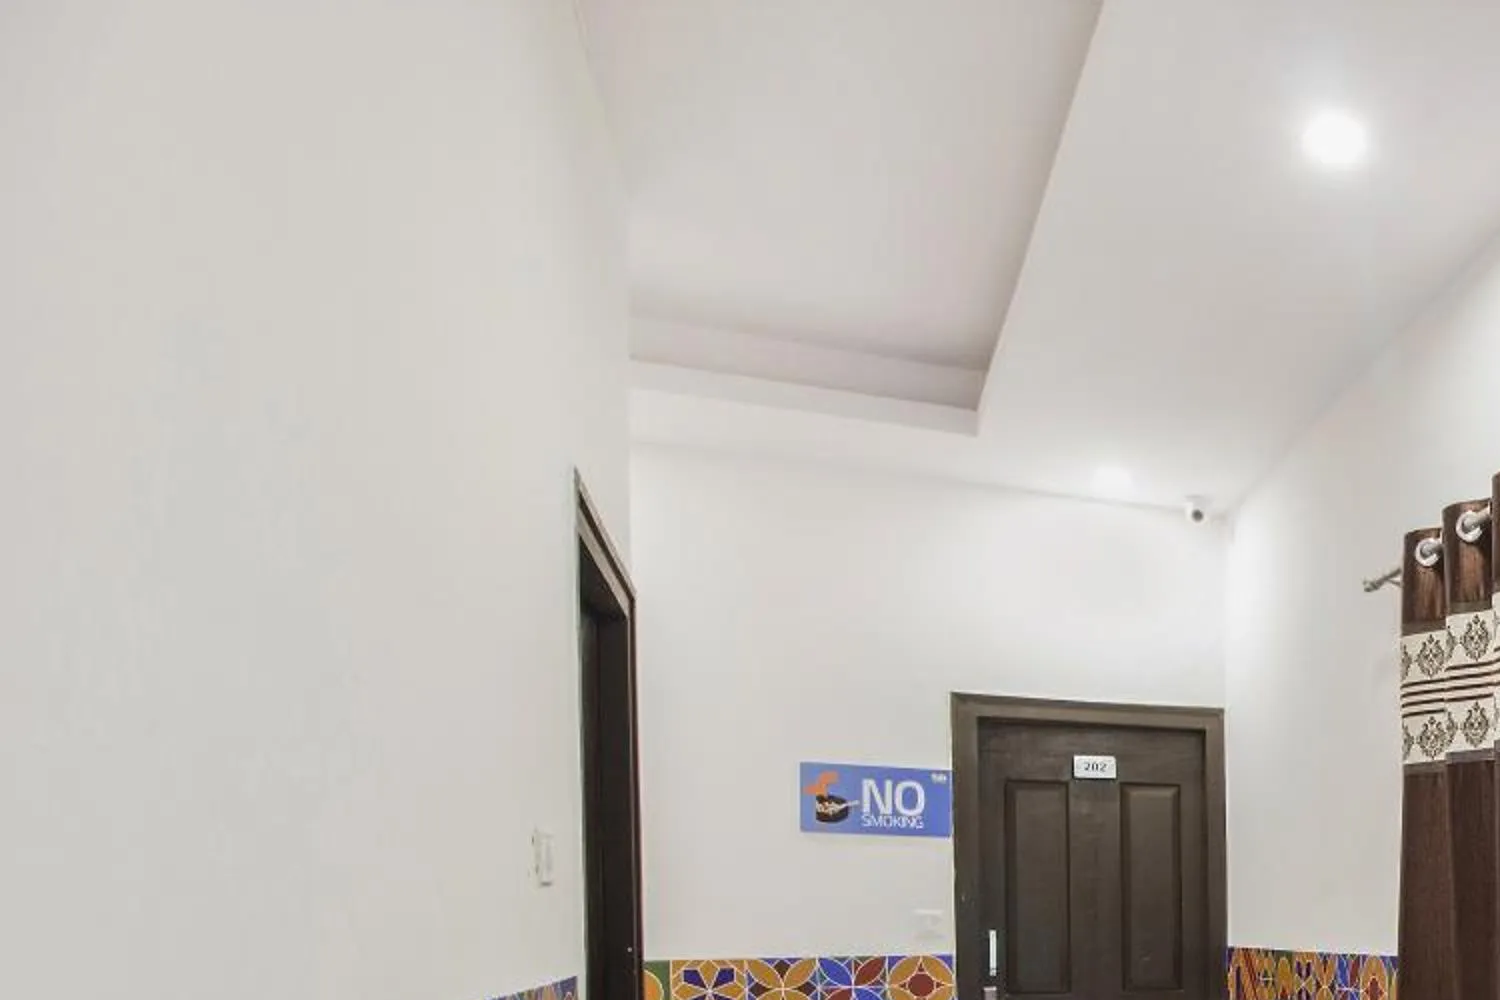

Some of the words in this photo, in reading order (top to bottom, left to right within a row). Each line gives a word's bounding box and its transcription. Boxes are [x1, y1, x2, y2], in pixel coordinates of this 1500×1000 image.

[1084, 760, 1107, 773] 202
[862, 778, 925, 815] NO
[861, 815, 924, 829] SMOKING
